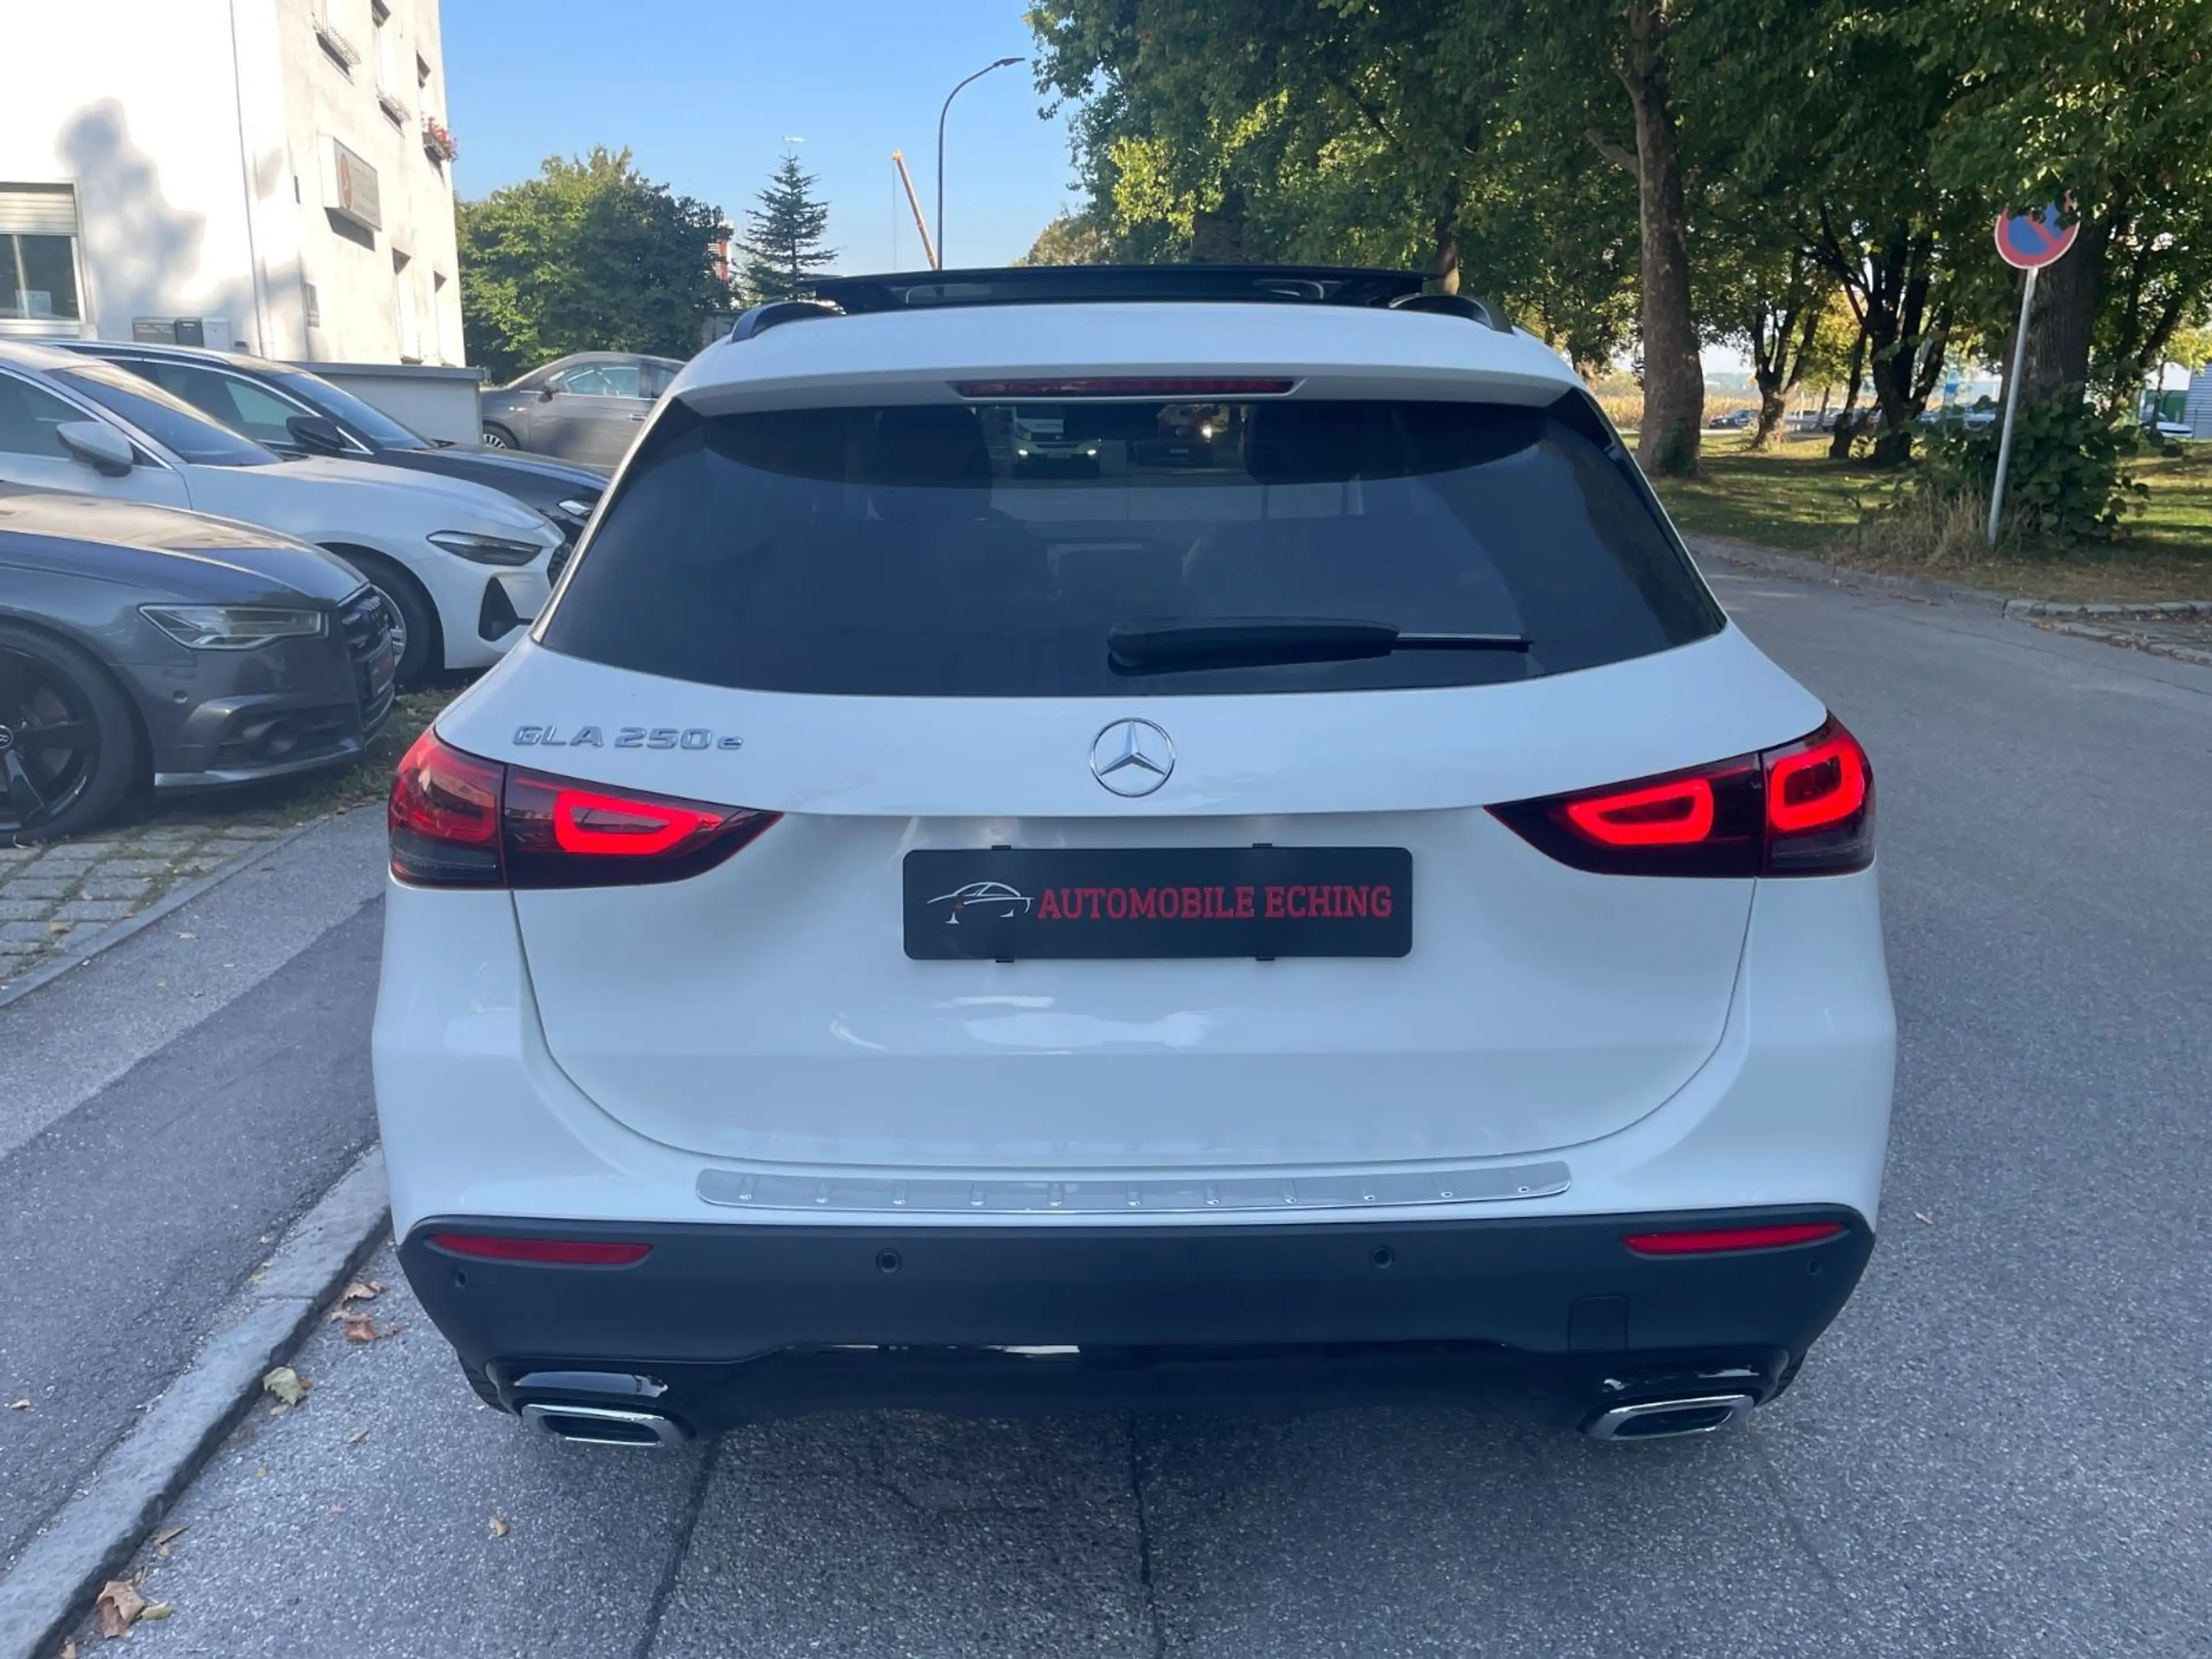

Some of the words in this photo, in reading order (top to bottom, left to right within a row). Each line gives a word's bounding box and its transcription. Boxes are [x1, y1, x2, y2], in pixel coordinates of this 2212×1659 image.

[512, 725, 605, 747] GLA
[1037, 886, 1255, 919] AUTOMOBILE
[1265, 885, 1393, 918] ECHING
